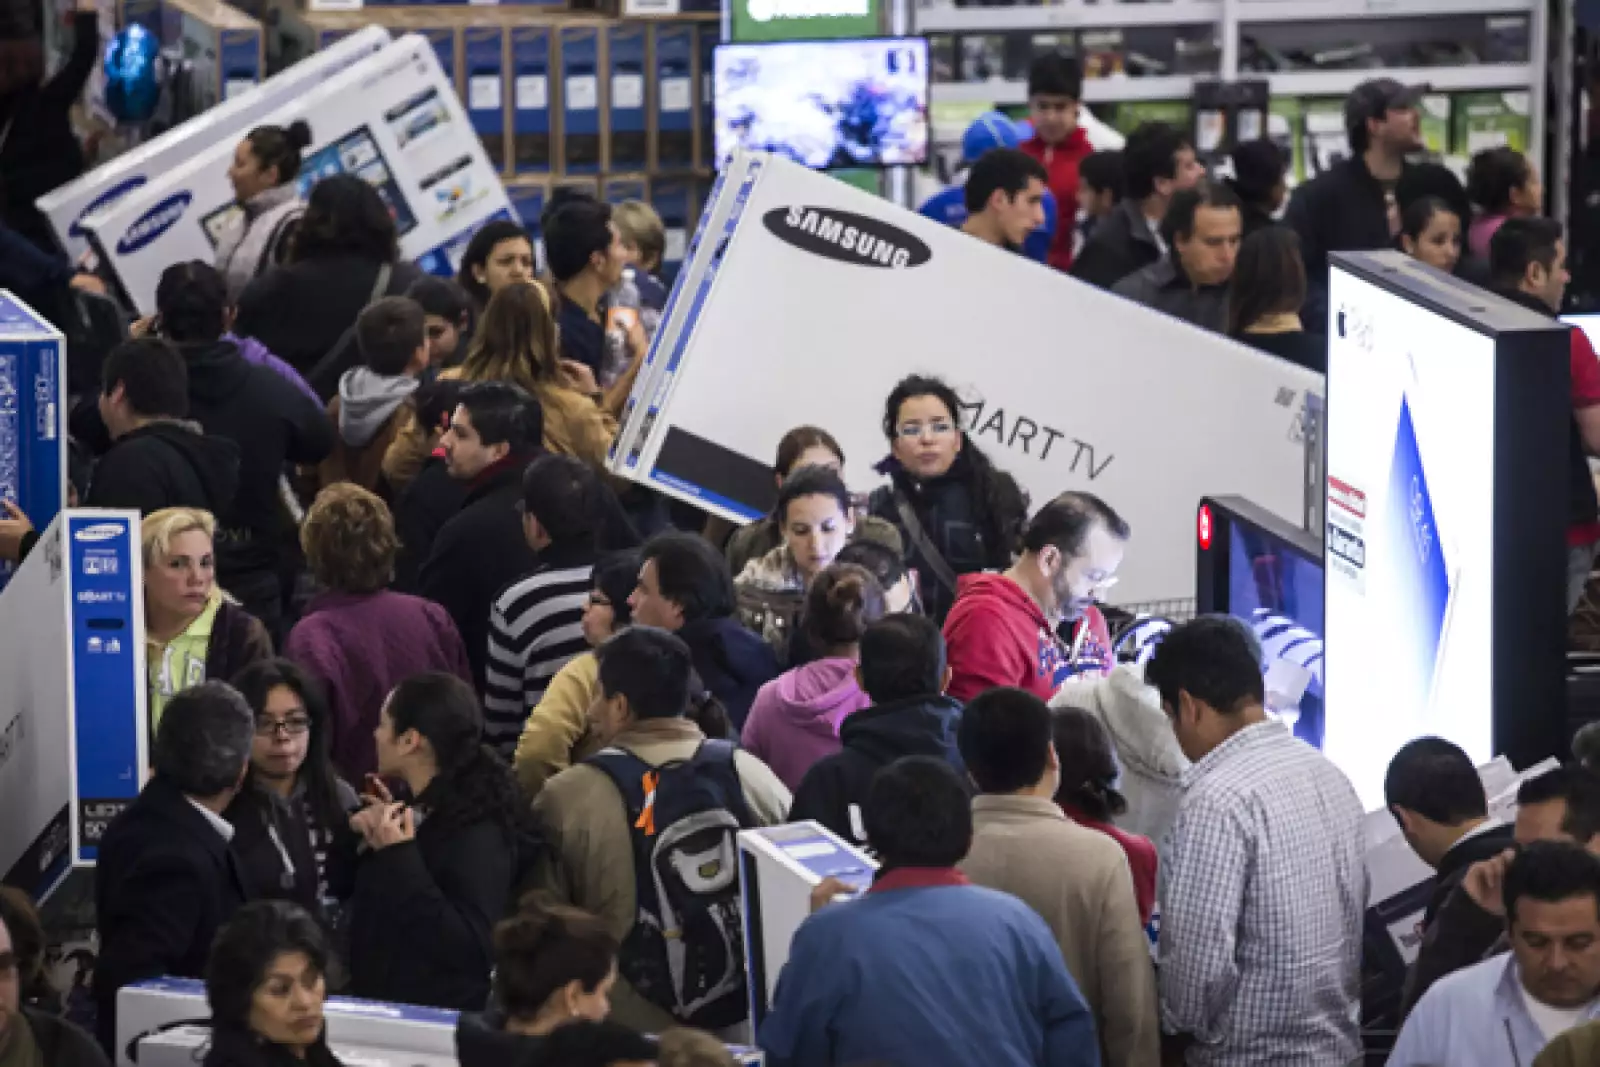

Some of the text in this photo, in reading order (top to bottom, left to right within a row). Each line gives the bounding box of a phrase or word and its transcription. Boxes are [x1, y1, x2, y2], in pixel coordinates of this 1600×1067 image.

[785, 204, 910, 268] SAMSUNG
[954, 398, 1115, 481] MART TV
